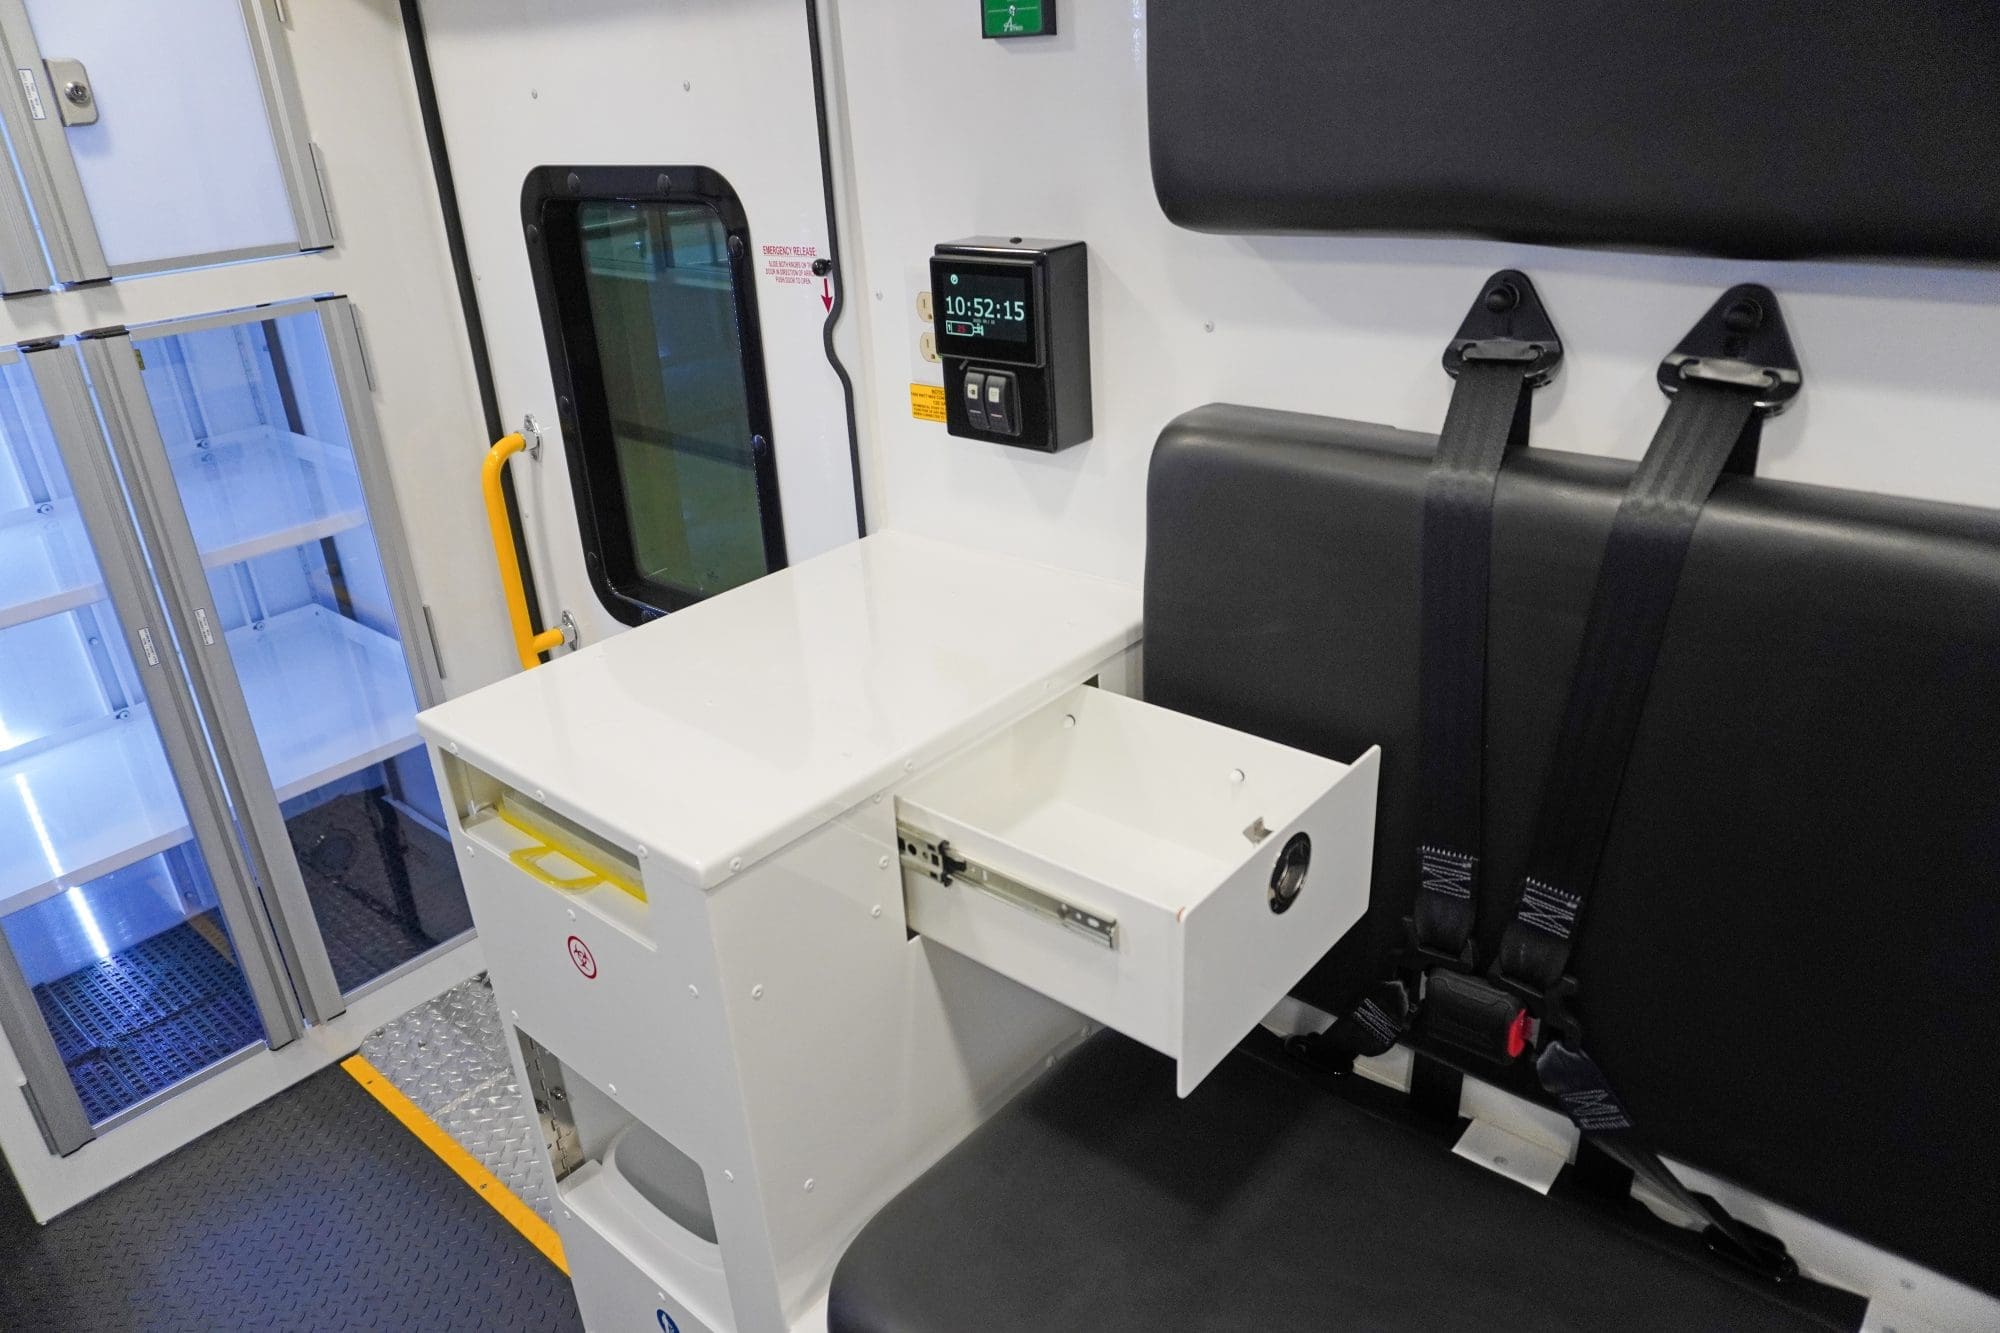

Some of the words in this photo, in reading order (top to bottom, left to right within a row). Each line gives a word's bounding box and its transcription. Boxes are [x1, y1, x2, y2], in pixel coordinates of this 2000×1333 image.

[762, 245, 791, 256] EMERGENCY
[793, 246, 816, 257] RELEASE
[945, 295, 1025, 322] 10:52:15
